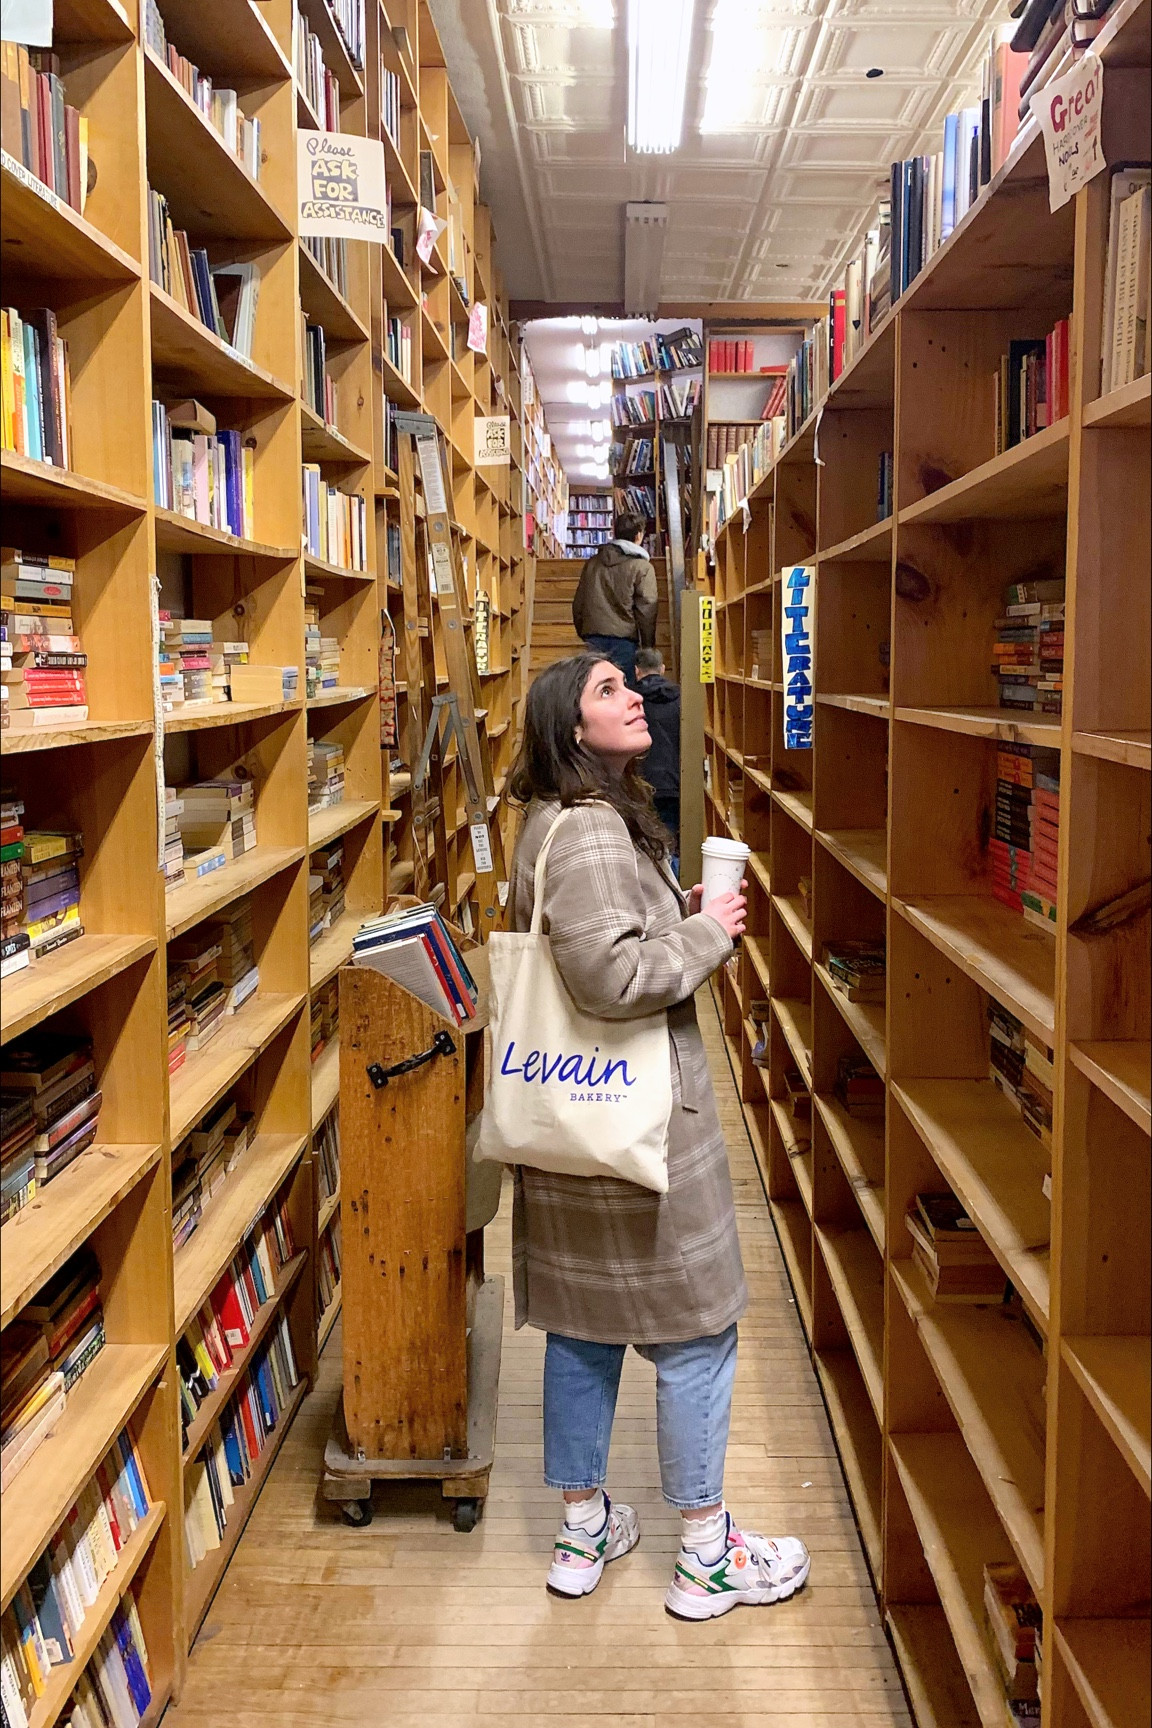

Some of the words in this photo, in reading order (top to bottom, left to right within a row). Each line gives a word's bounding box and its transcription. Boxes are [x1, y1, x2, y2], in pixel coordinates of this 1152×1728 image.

[306, 137, 355, 156] Please
[311, 159, 359, 180] ASK
[312, 179, 359, 201] FOR
[301, 201, 385, 228] ASSISTANCE
[784, 567, 813, 748] LITERATURE
[501, 1041, 636, 1086] Levain
